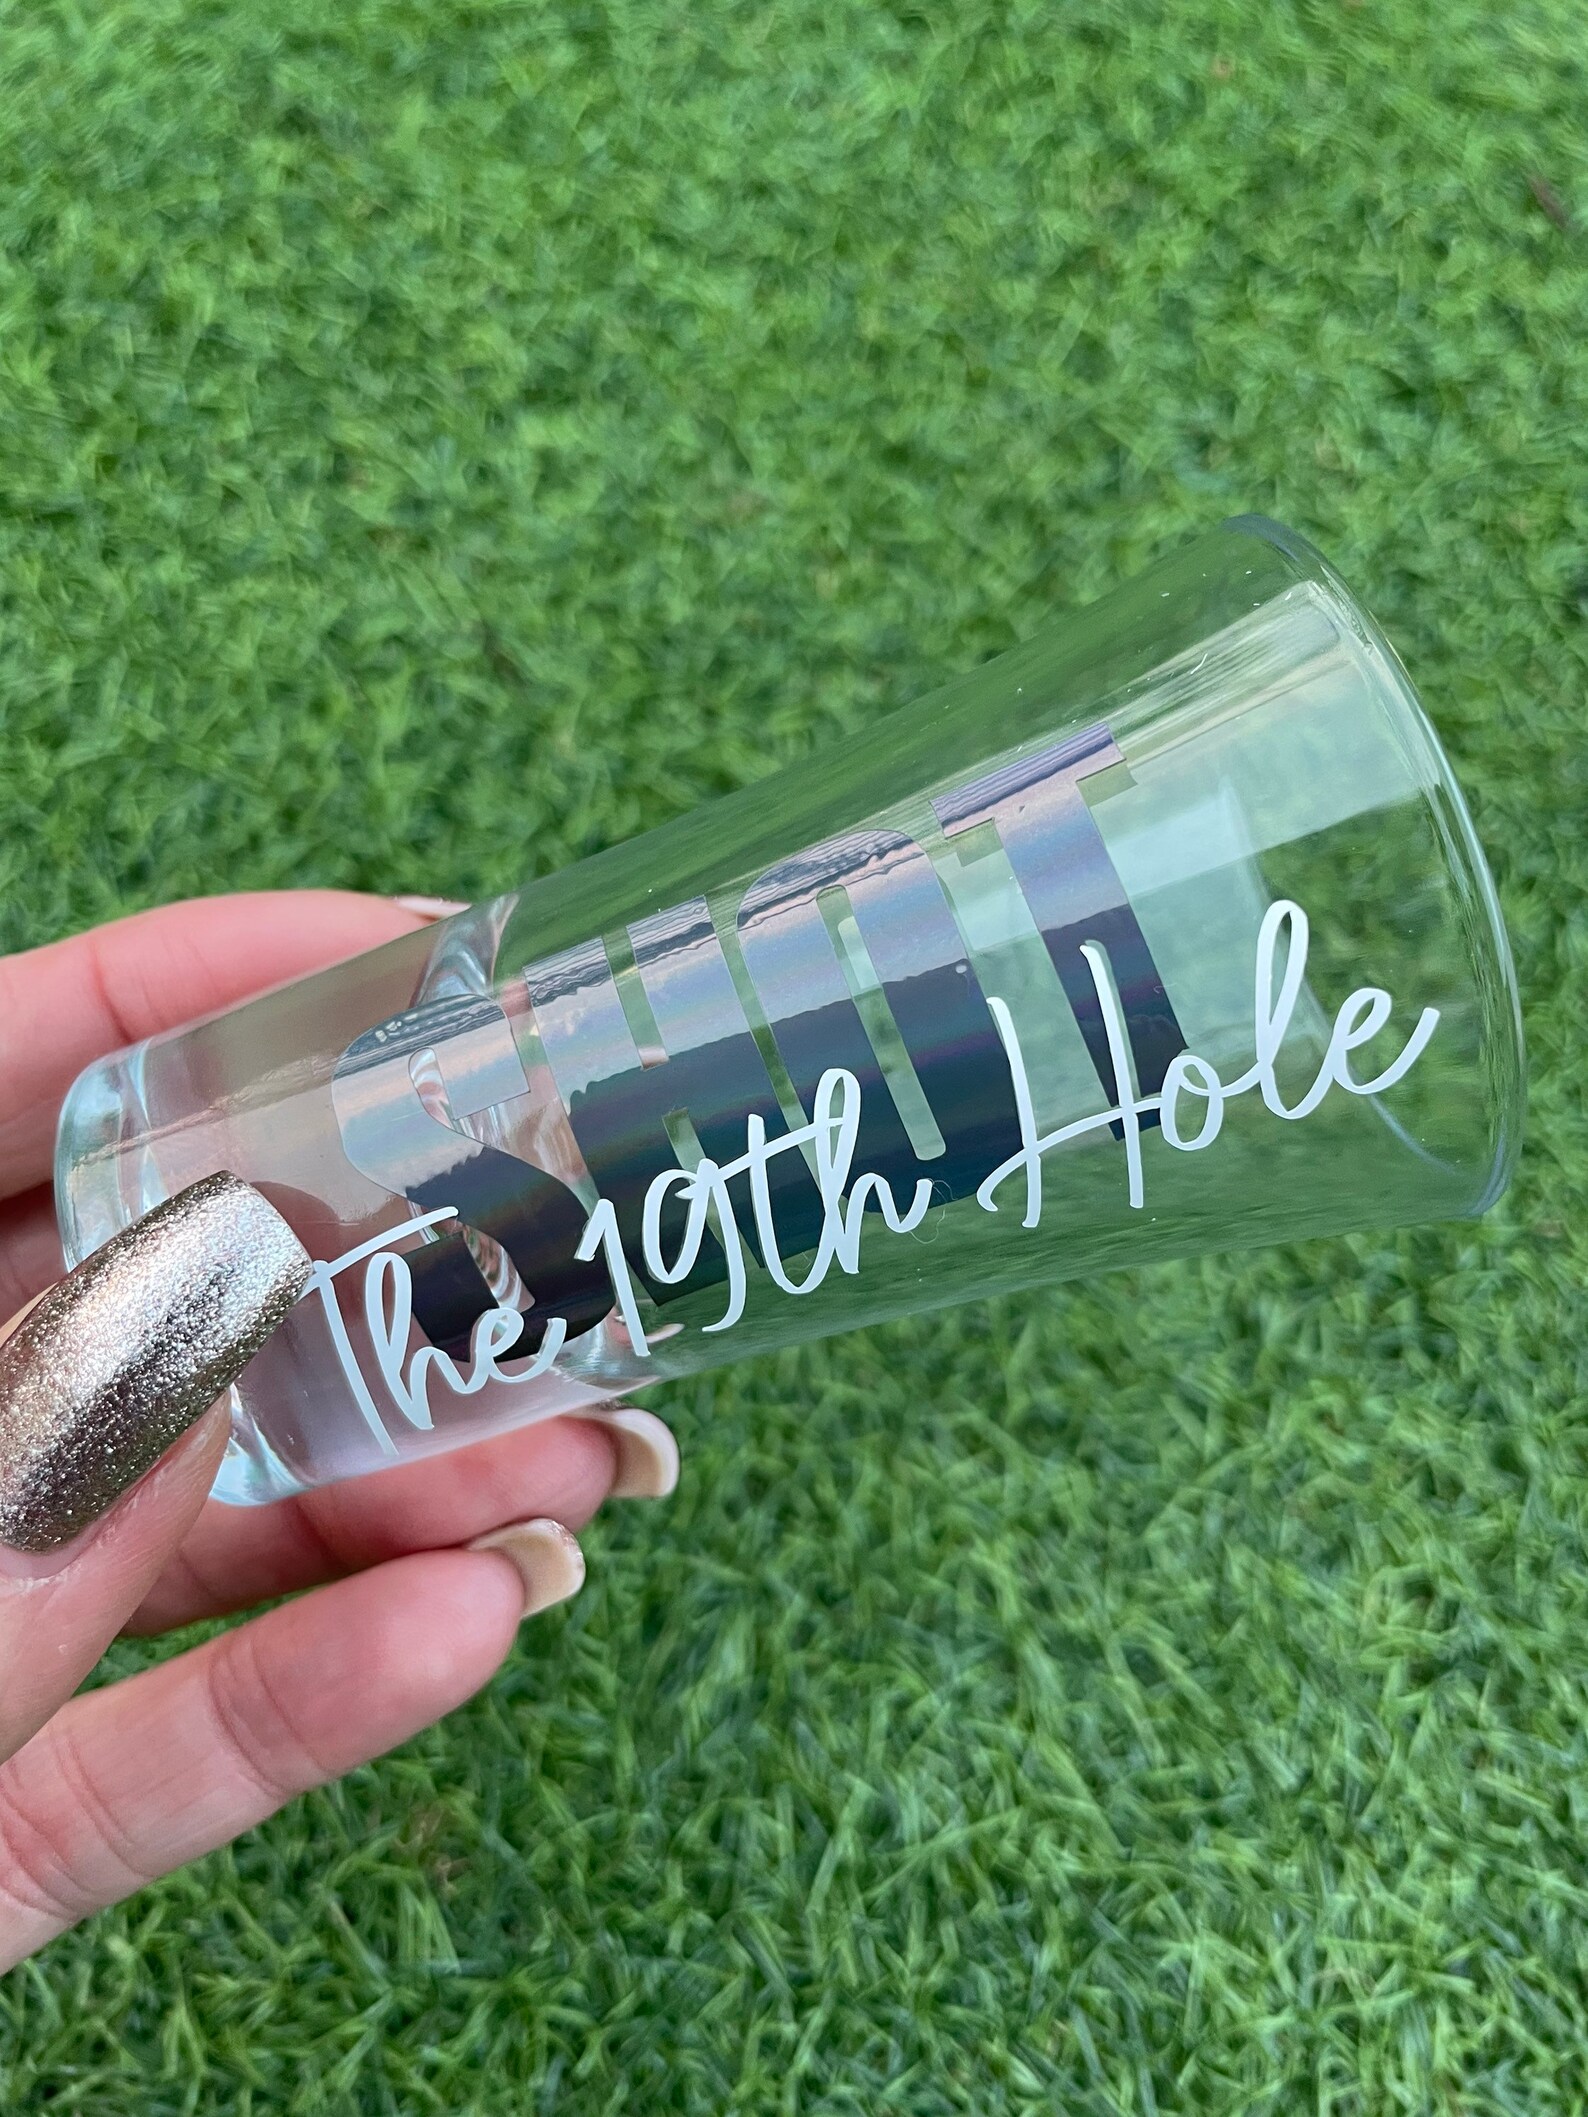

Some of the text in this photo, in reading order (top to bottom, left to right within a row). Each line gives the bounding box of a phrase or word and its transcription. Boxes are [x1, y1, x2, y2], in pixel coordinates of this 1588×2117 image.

[303, 899, 1441, 1455] The 19th Hole
[332, 722, 1188, 1363] SHOT
